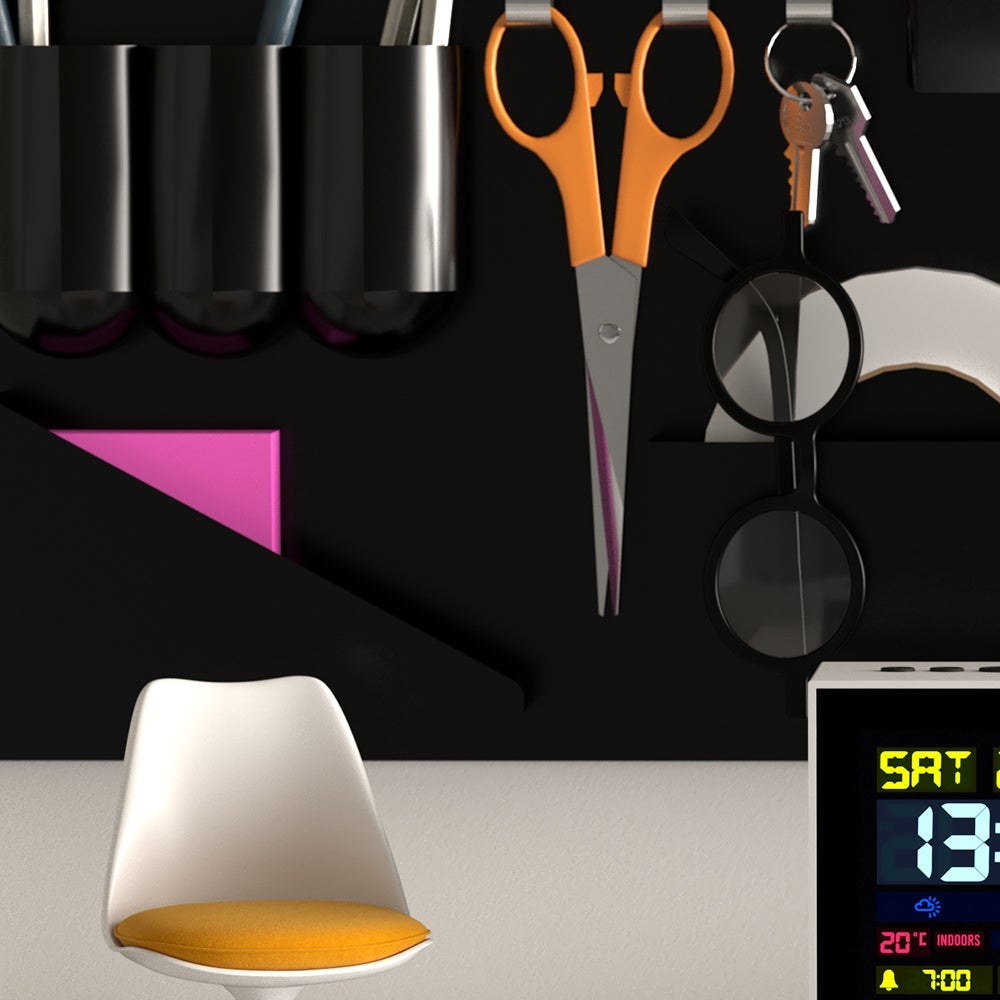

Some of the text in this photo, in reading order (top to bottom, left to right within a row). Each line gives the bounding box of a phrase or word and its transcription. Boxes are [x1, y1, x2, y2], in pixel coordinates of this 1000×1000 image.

[880, 751, 971, 789] SAT
[937, 934, 980, 947] INDOORS
[923, 970, 970, 991] 7:00
